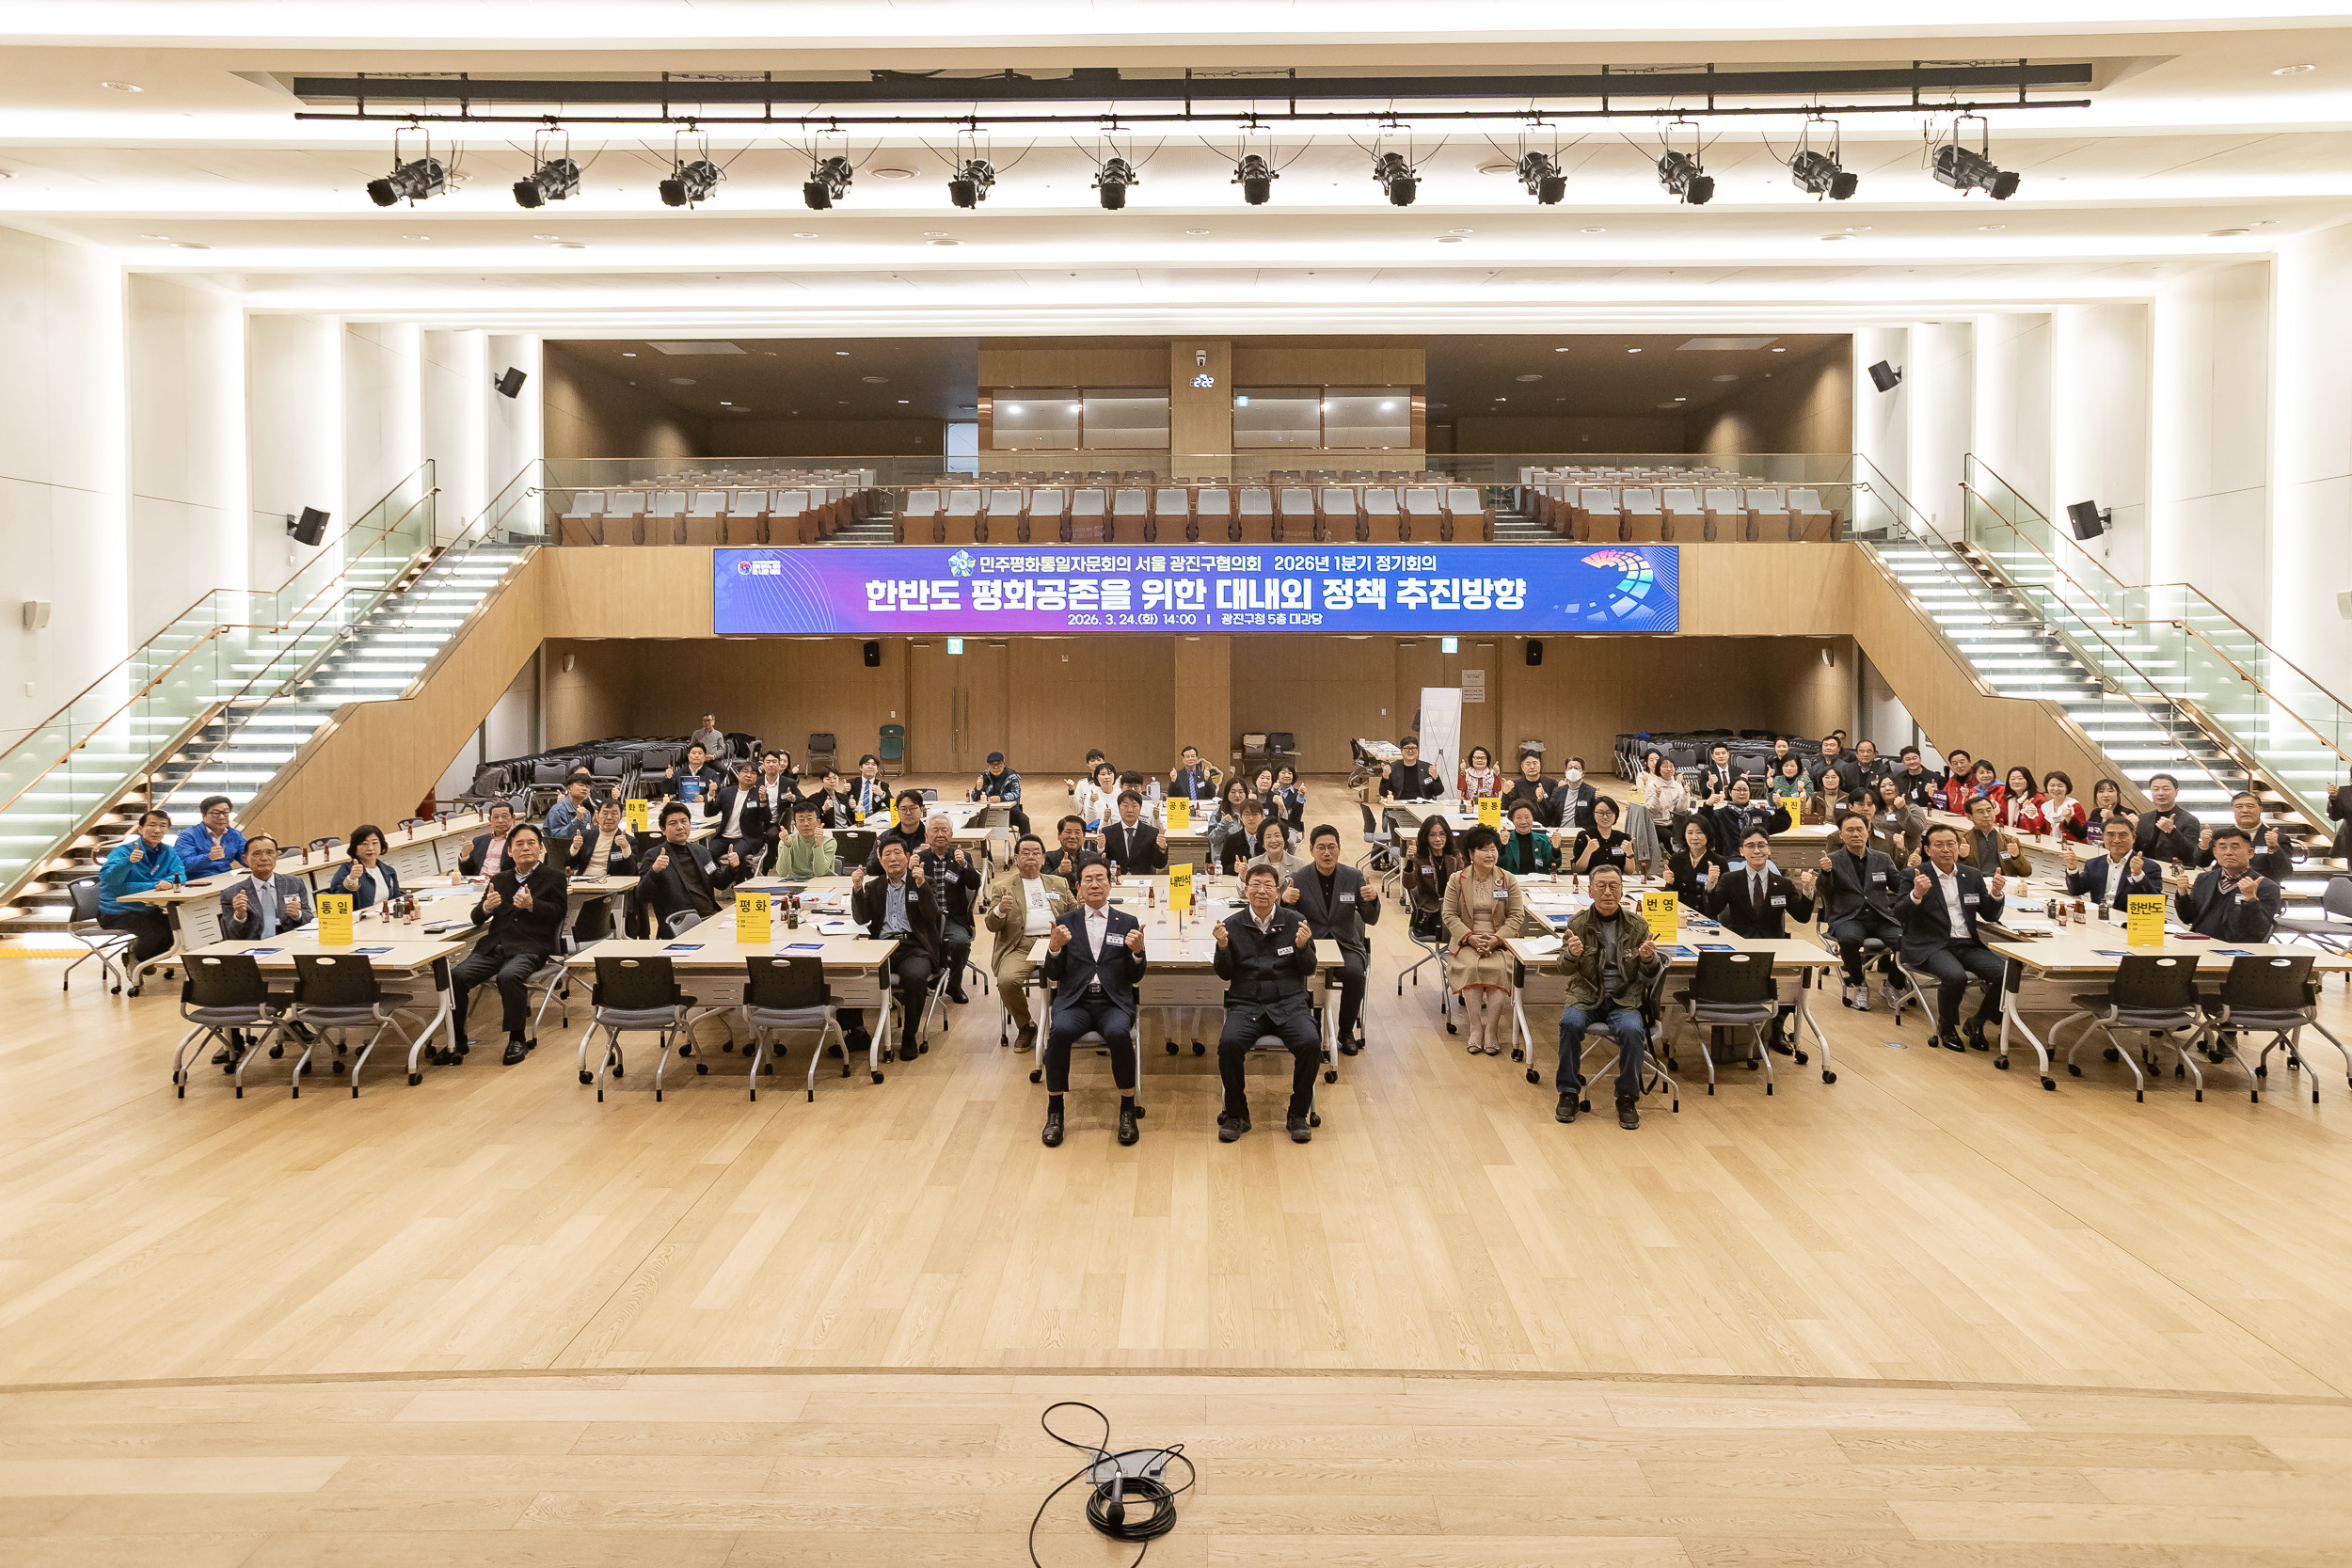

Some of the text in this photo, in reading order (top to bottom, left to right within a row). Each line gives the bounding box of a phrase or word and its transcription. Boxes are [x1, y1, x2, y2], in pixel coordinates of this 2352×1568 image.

[979, 555, 1437, 573] 민주평화통일자문회의 서울 광진구협의회 2026년 1분기 정기회의
[865, 578, 1527, 612] 한반도 평화공존을 위한 대내외 정책 추진방향
[1067, 613, 1323, 626] 2026. 3. 24.(화) 14:00 광진구청 5층 대강당
[1170, 874, 1191, 887] 내빈석
[321, 901, 348, 914] 통일
[739, 899, 767, 912] 평화
[1646, 899, 1674, 912] 번영
[2129, 902, 2164, 916] 한반도
